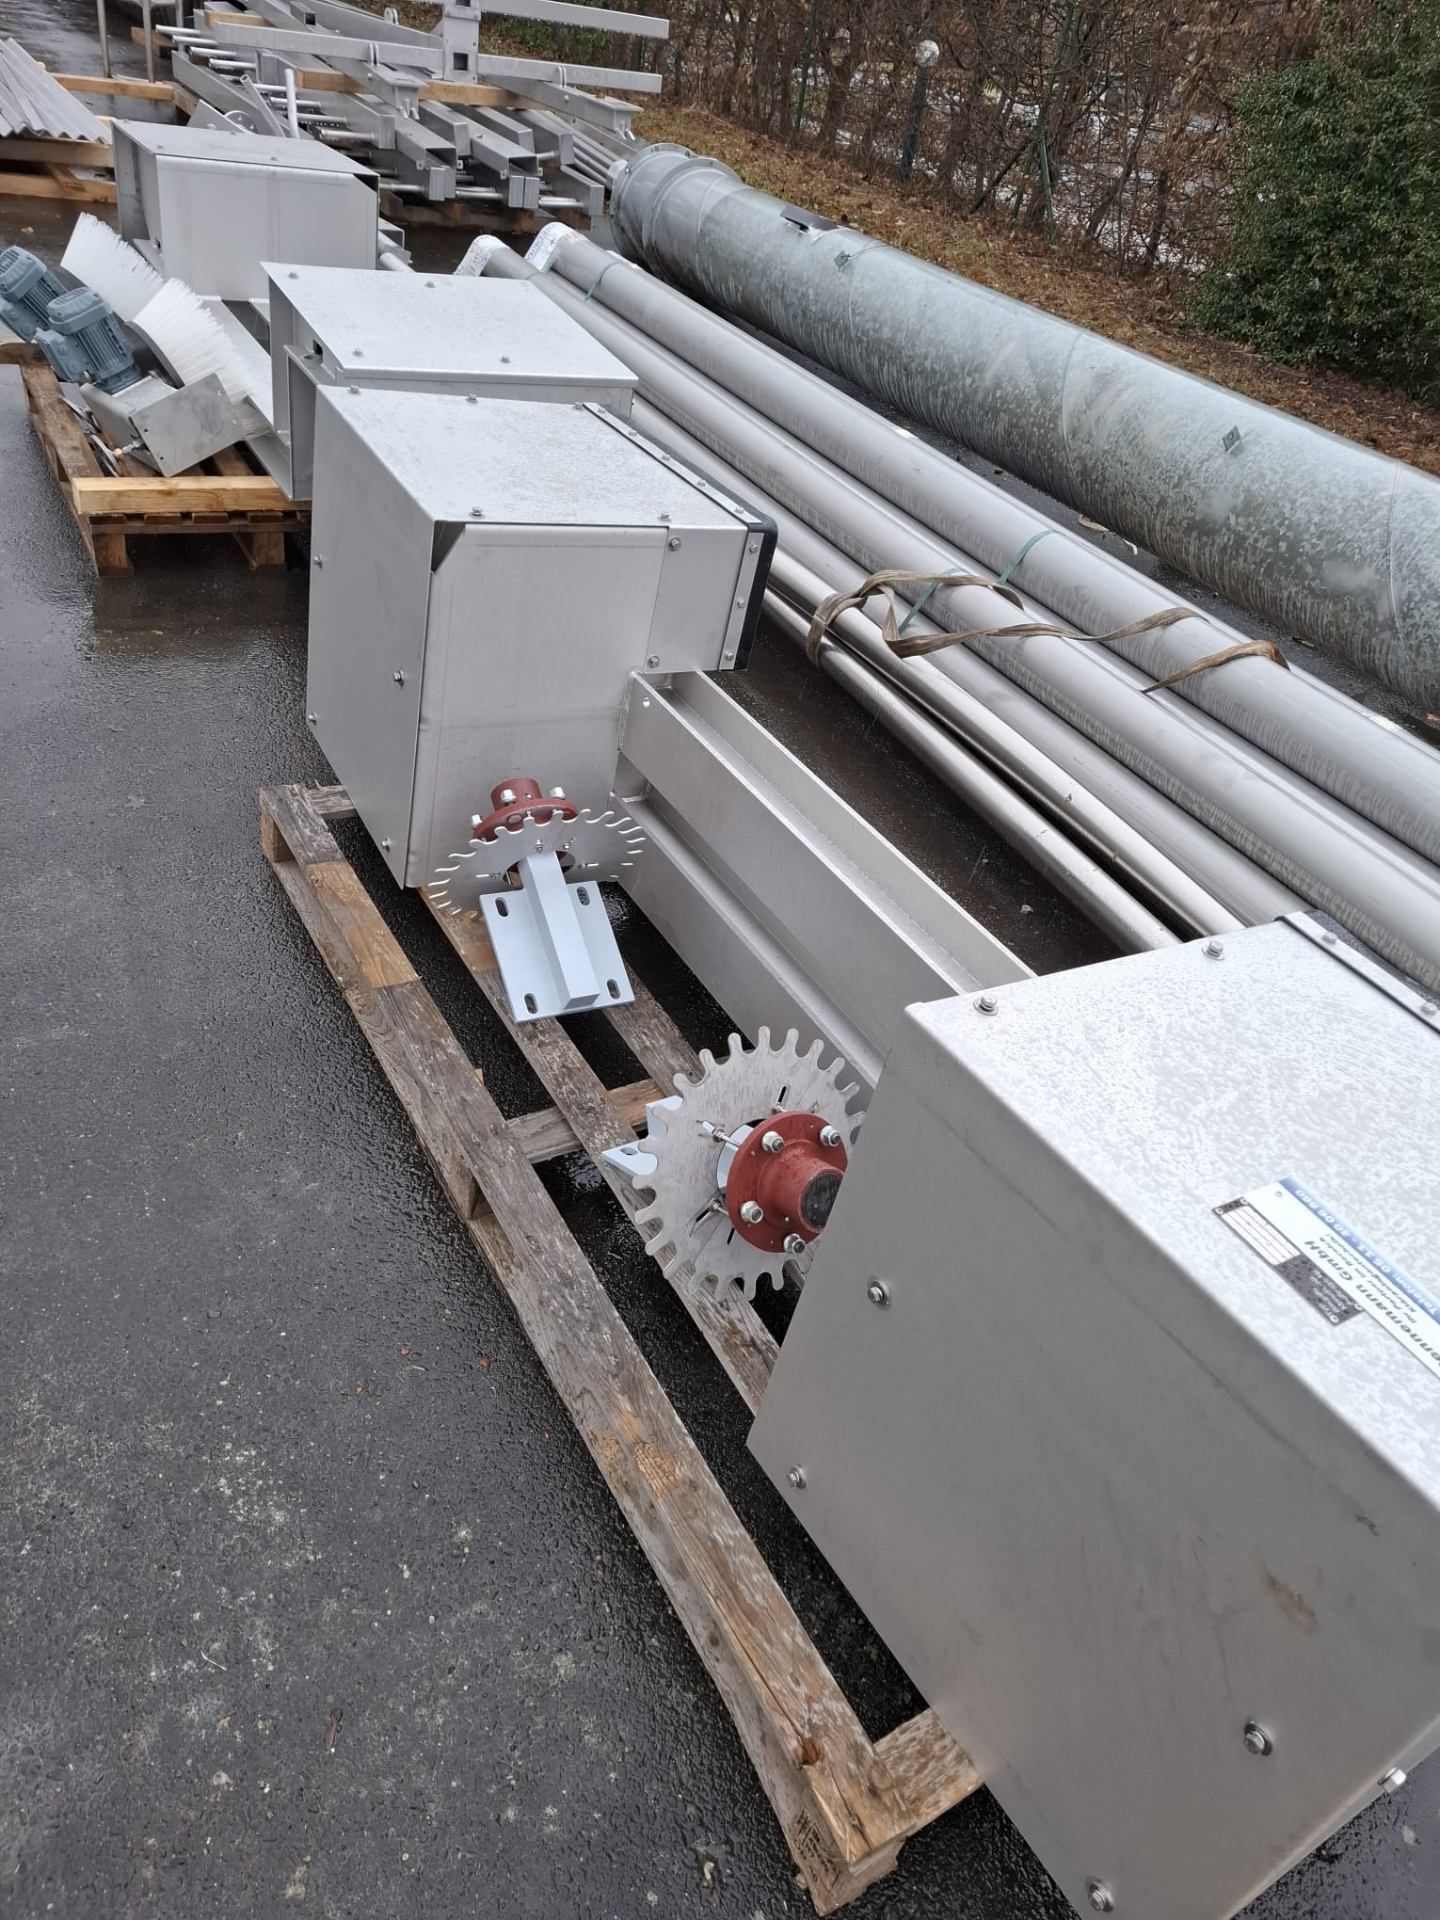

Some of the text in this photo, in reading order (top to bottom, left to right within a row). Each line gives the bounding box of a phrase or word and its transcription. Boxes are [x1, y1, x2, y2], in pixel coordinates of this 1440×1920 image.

[1304, 1239, 1440, 1367] ennemann GmbH
[1366, 1279, 1402, 1310] Partner
